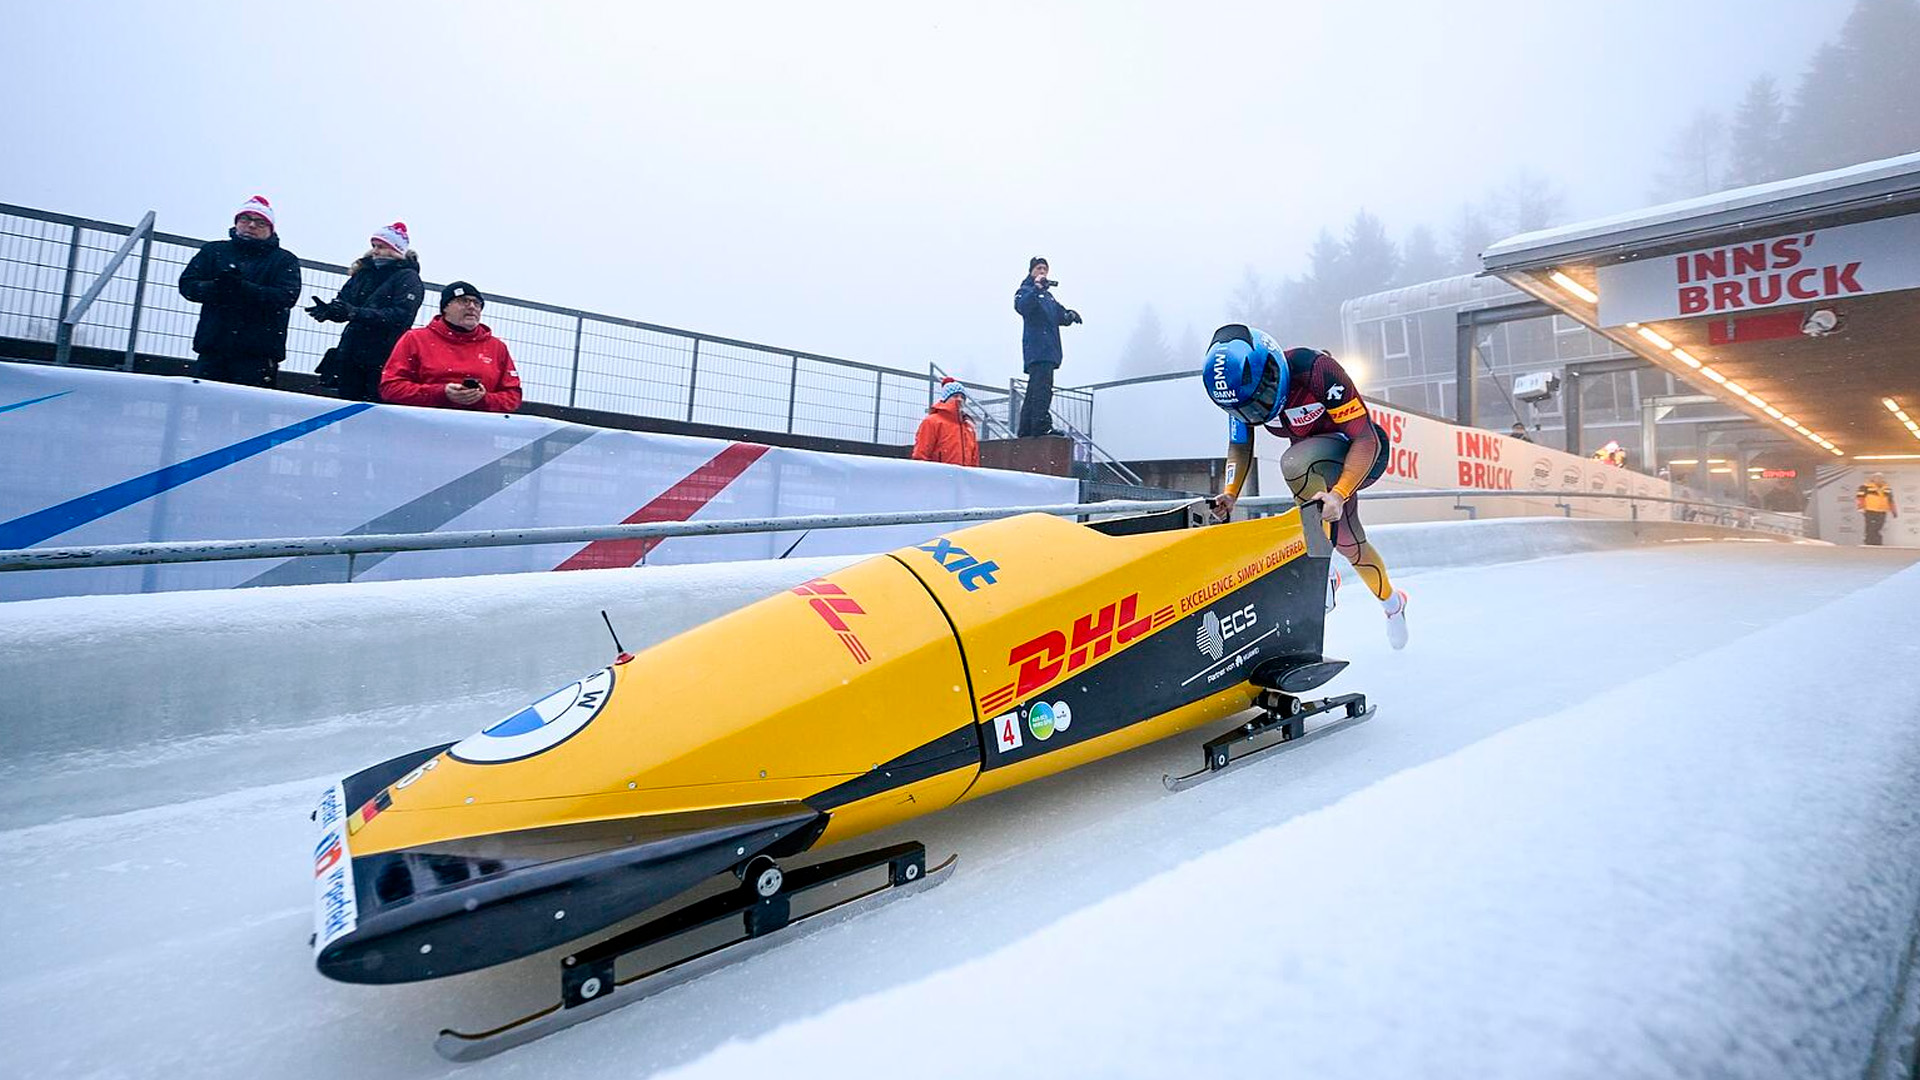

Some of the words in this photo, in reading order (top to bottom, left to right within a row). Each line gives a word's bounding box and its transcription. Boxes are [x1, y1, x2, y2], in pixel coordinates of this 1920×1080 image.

[1677, 233, 1815, 284] INNS'
[1678, 262, 1864, 315] BRUCK
[1214, 354, 1228, 390] BMW
[1457, 432, 1503, 462] INNS'
[1459, 461, 1513, 490] BRUCK
[1181, 575, 1236, 613] EXCELLENCE.
[1237, 559, 1264, 584] SIMPLY
[1221, 603, 1257, 640] ECS
[1008, 592, 1153, 698] DHL
[1002, 718, 1016, 745] 4
